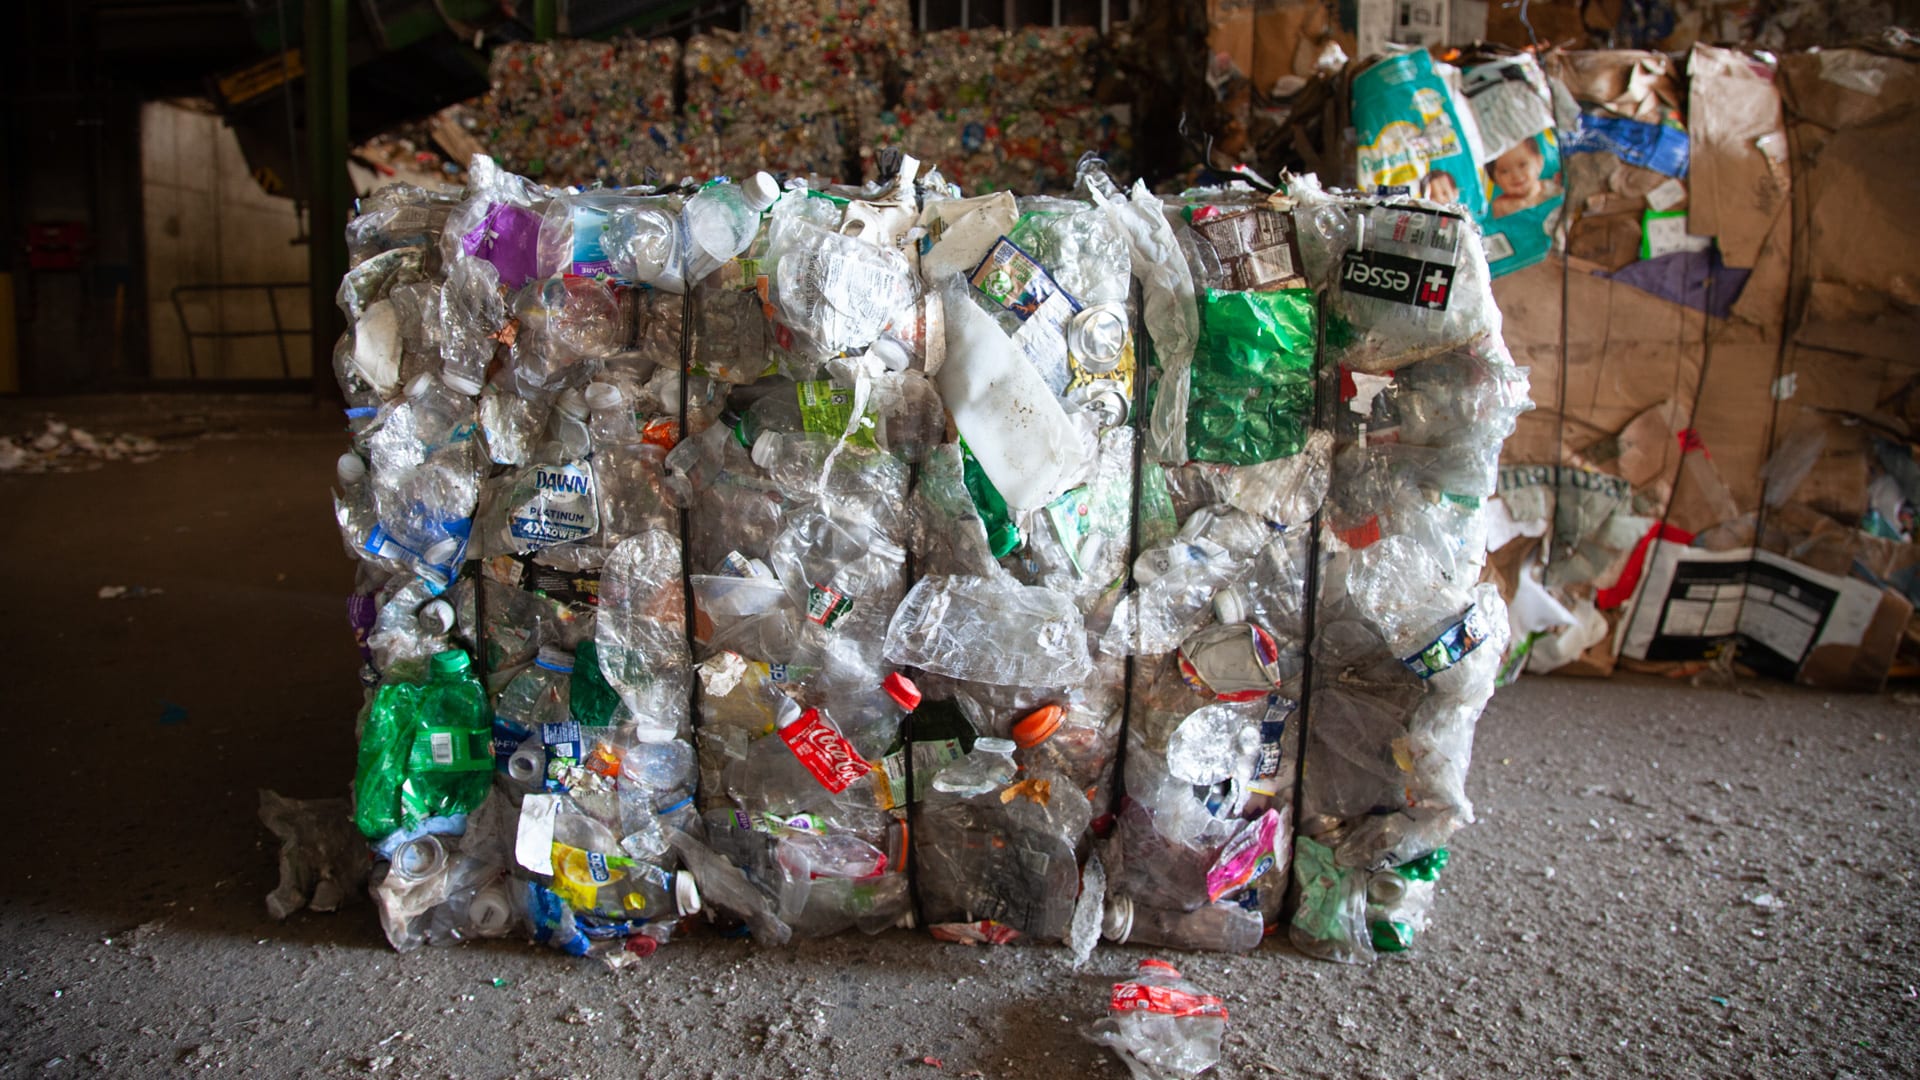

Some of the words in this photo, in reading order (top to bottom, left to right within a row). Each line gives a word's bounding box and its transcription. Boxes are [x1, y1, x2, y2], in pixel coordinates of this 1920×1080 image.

[581, 266, 605, 274] CARE
[535, 470, 589, 496] DAWN
[530, 506, 585, 523] PLATINUM
[522, 521, 543, 535] 4X
